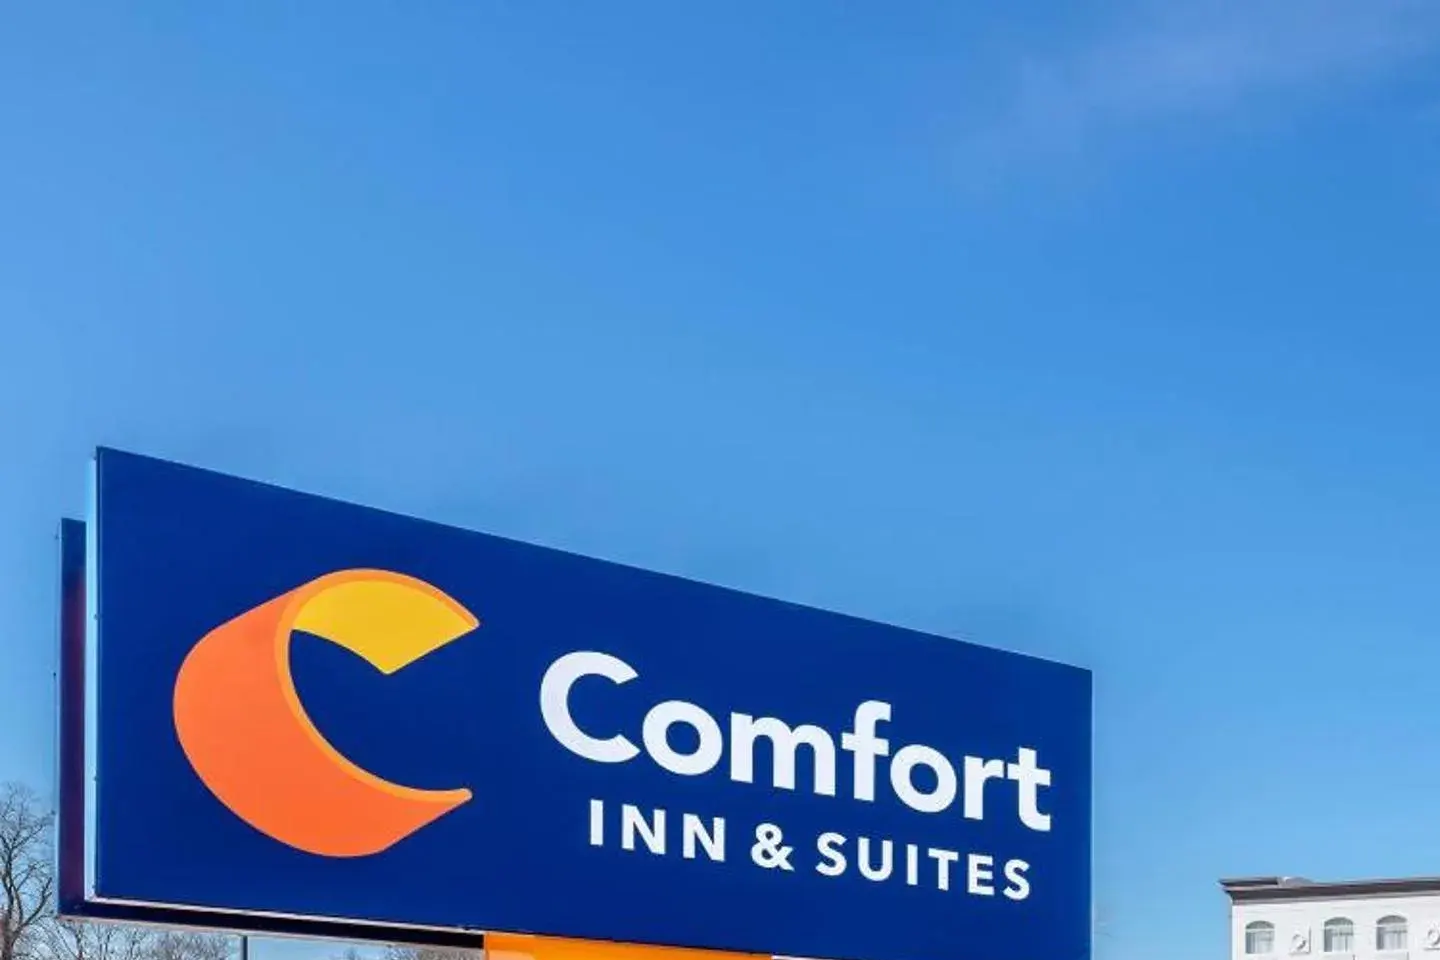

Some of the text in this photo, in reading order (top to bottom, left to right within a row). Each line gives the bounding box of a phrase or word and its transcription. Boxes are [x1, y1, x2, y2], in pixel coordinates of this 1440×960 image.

[540, 650, 1051, 832] Comfort
[589, 799, 1031, 900] INN & SUITES
